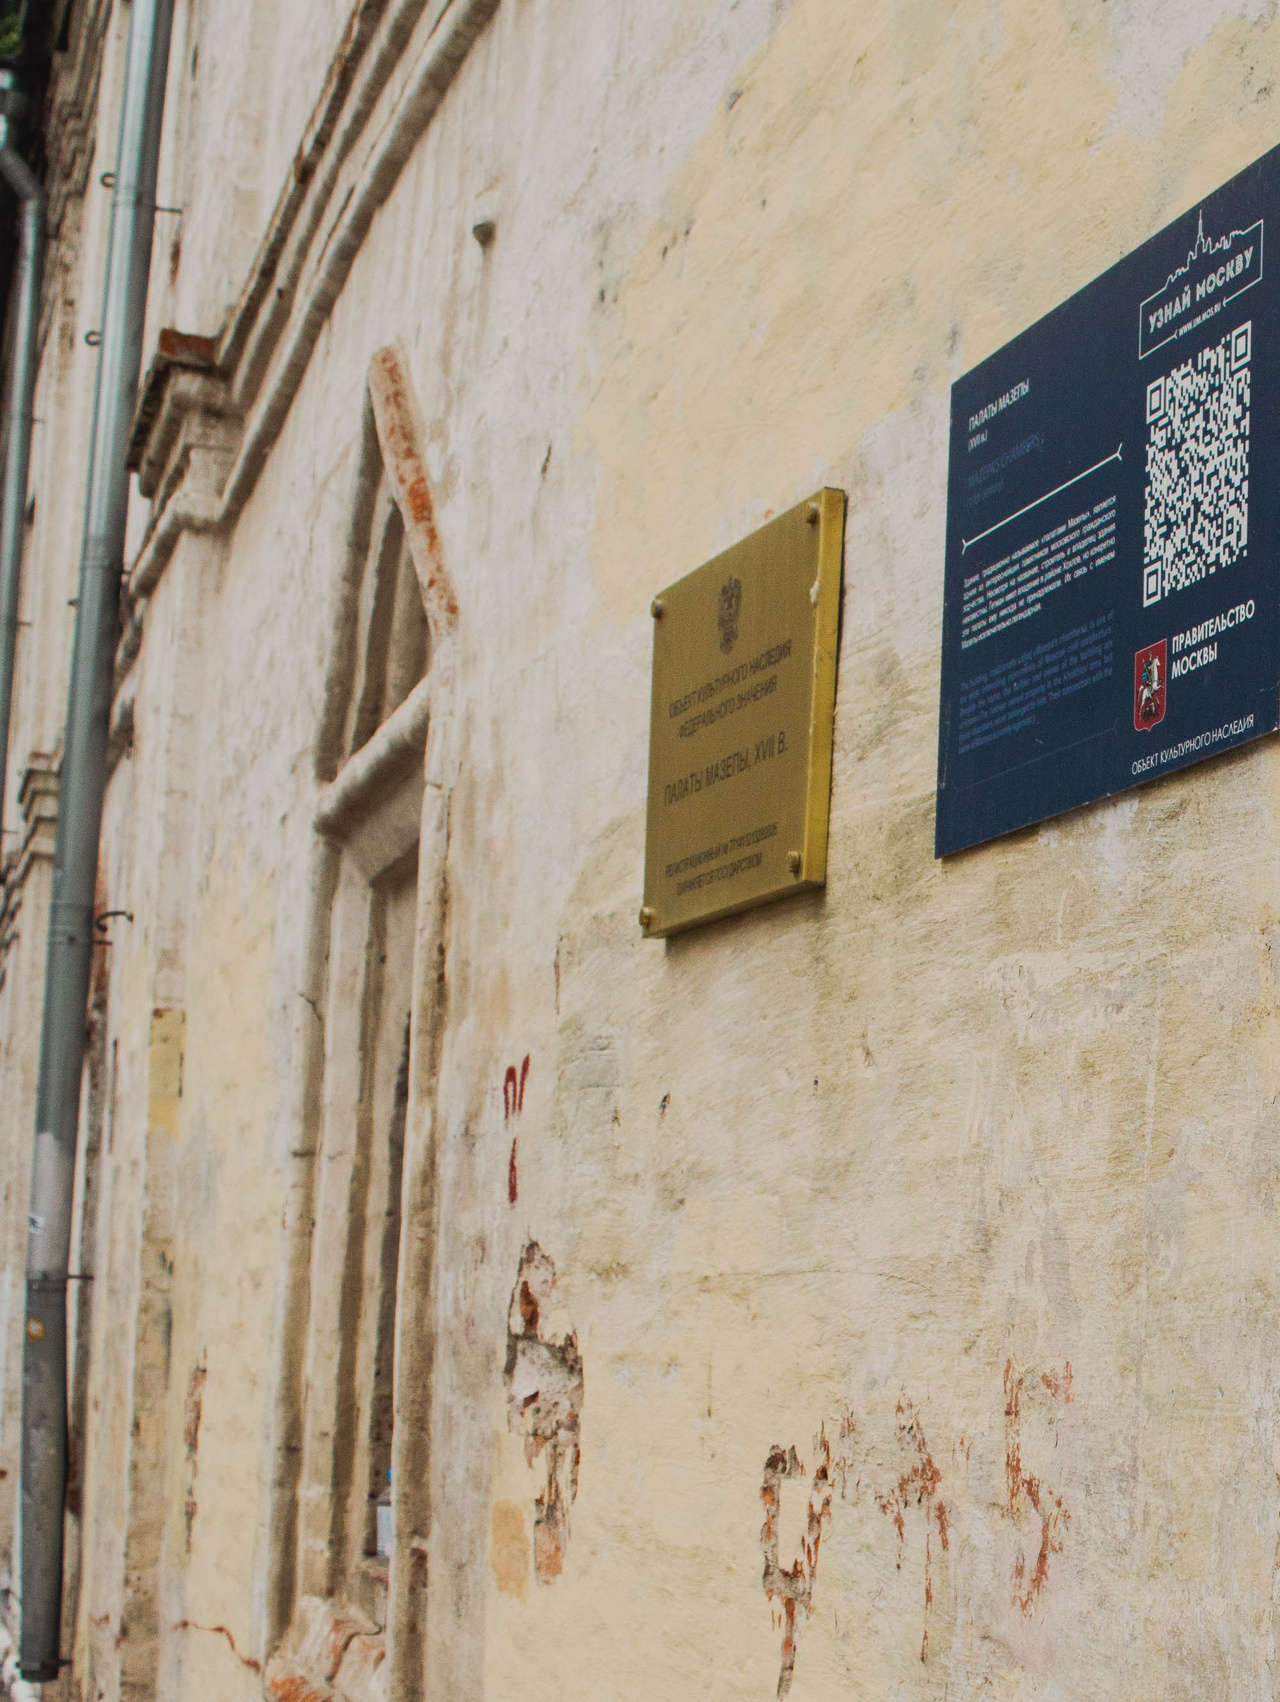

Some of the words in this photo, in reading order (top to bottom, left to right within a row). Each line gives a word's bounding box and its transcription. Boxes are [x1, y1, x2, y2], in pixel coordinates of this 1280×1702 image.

[1148, 283, 1190, 334] УЗНАЙ
[1196, 245, 1253, 302] МОСКВУ
[968, 398, 997, 433] ПАЛАТЫ
[998, 376, 1029, 413] МАЗЕПЫ
[1172, 599, 1255, 654] ПРАВИТЕЛЬСТВО
[1171, 642, 1218, 679] МОСКВЫ
[664, 768, 703, 807] ПАЛАТЫ
[705, 745, 750, 790] МАЗЕПЫ,
[754, 733, 775, 766] XVII
[777, 727, 787, 755] В.
[1131, 752, 1159, 775] ОБЪЕКТ
[1160, 731, 1211, 763] КУЛЬТУРНОГО
[1211, 713, 1254, 742] НАСЛЕДИЯ
